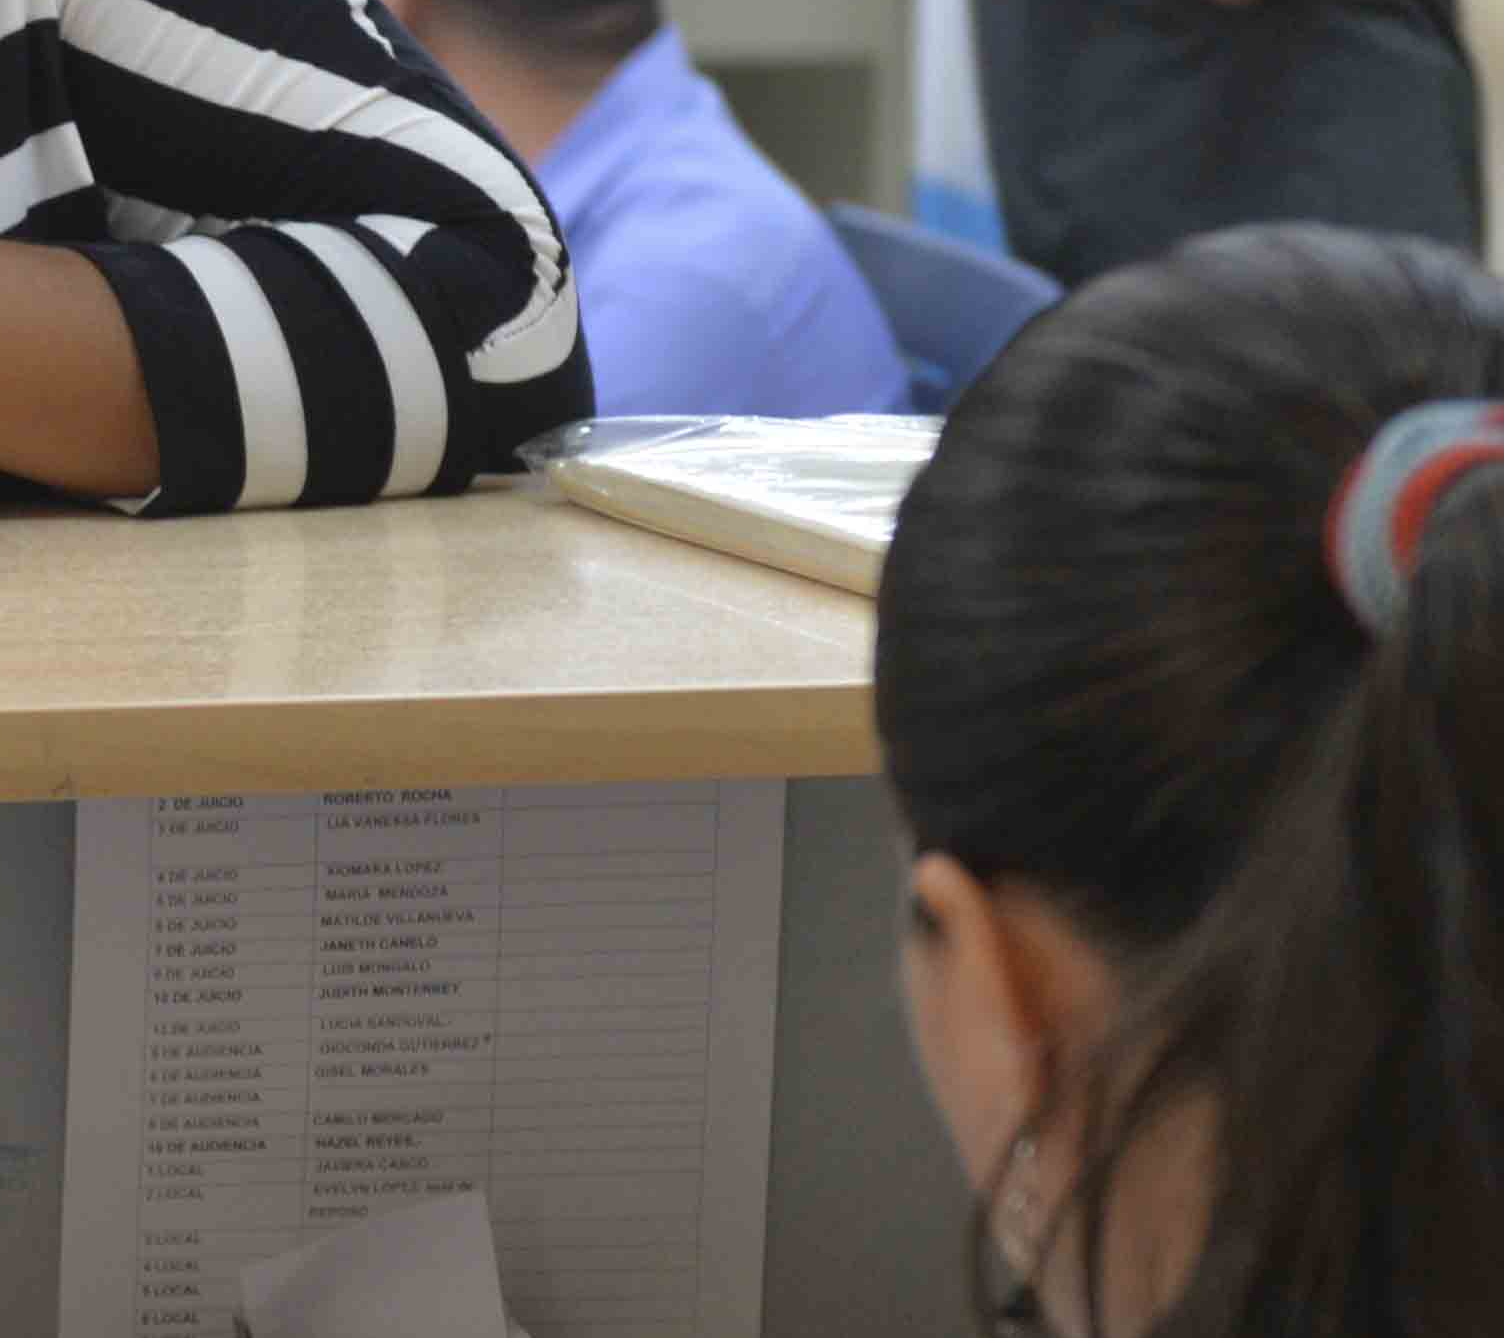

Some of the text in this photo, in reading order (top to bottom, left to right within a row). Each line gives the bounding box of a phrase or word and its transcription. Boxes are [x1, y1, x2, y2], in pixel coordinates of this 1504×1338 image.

[173, 796, 193, 812] DE
[322, 788, 453, 805] ROBERTO ROCHA
[169, 821, 189, 835] DE
[167, 868, 187, 885] DE
[166, 892, 186, 910] DE
[167, 916, 186, 934] DE
[165, 942, 186, 958] DE
[319, 940, 376, 952] JANETH
[165, 966, 184, 982] DE
[171, 990, 192, 1004] DE
[169, 1020, 189, 1036] DE
[161, 1044, 181, 1059] DE
[161, 1068, 180, 1083] DE
[159, 1092, 178, 1107] DE
[159, 1116, 179, 1132] DE
[166, 1140, 186, 1154] DE
[157, 1164, 204, 1178] LOCAL
[157, 1188, 204, 1201] LOCAL
[154, 1232, 201, 1246] LOCAL
[153, 1260, 201, 1273] LOCAL
[153, 1284, 201, 1298] LOCAL
[152, 1312, 201, 1326] LOCAL
